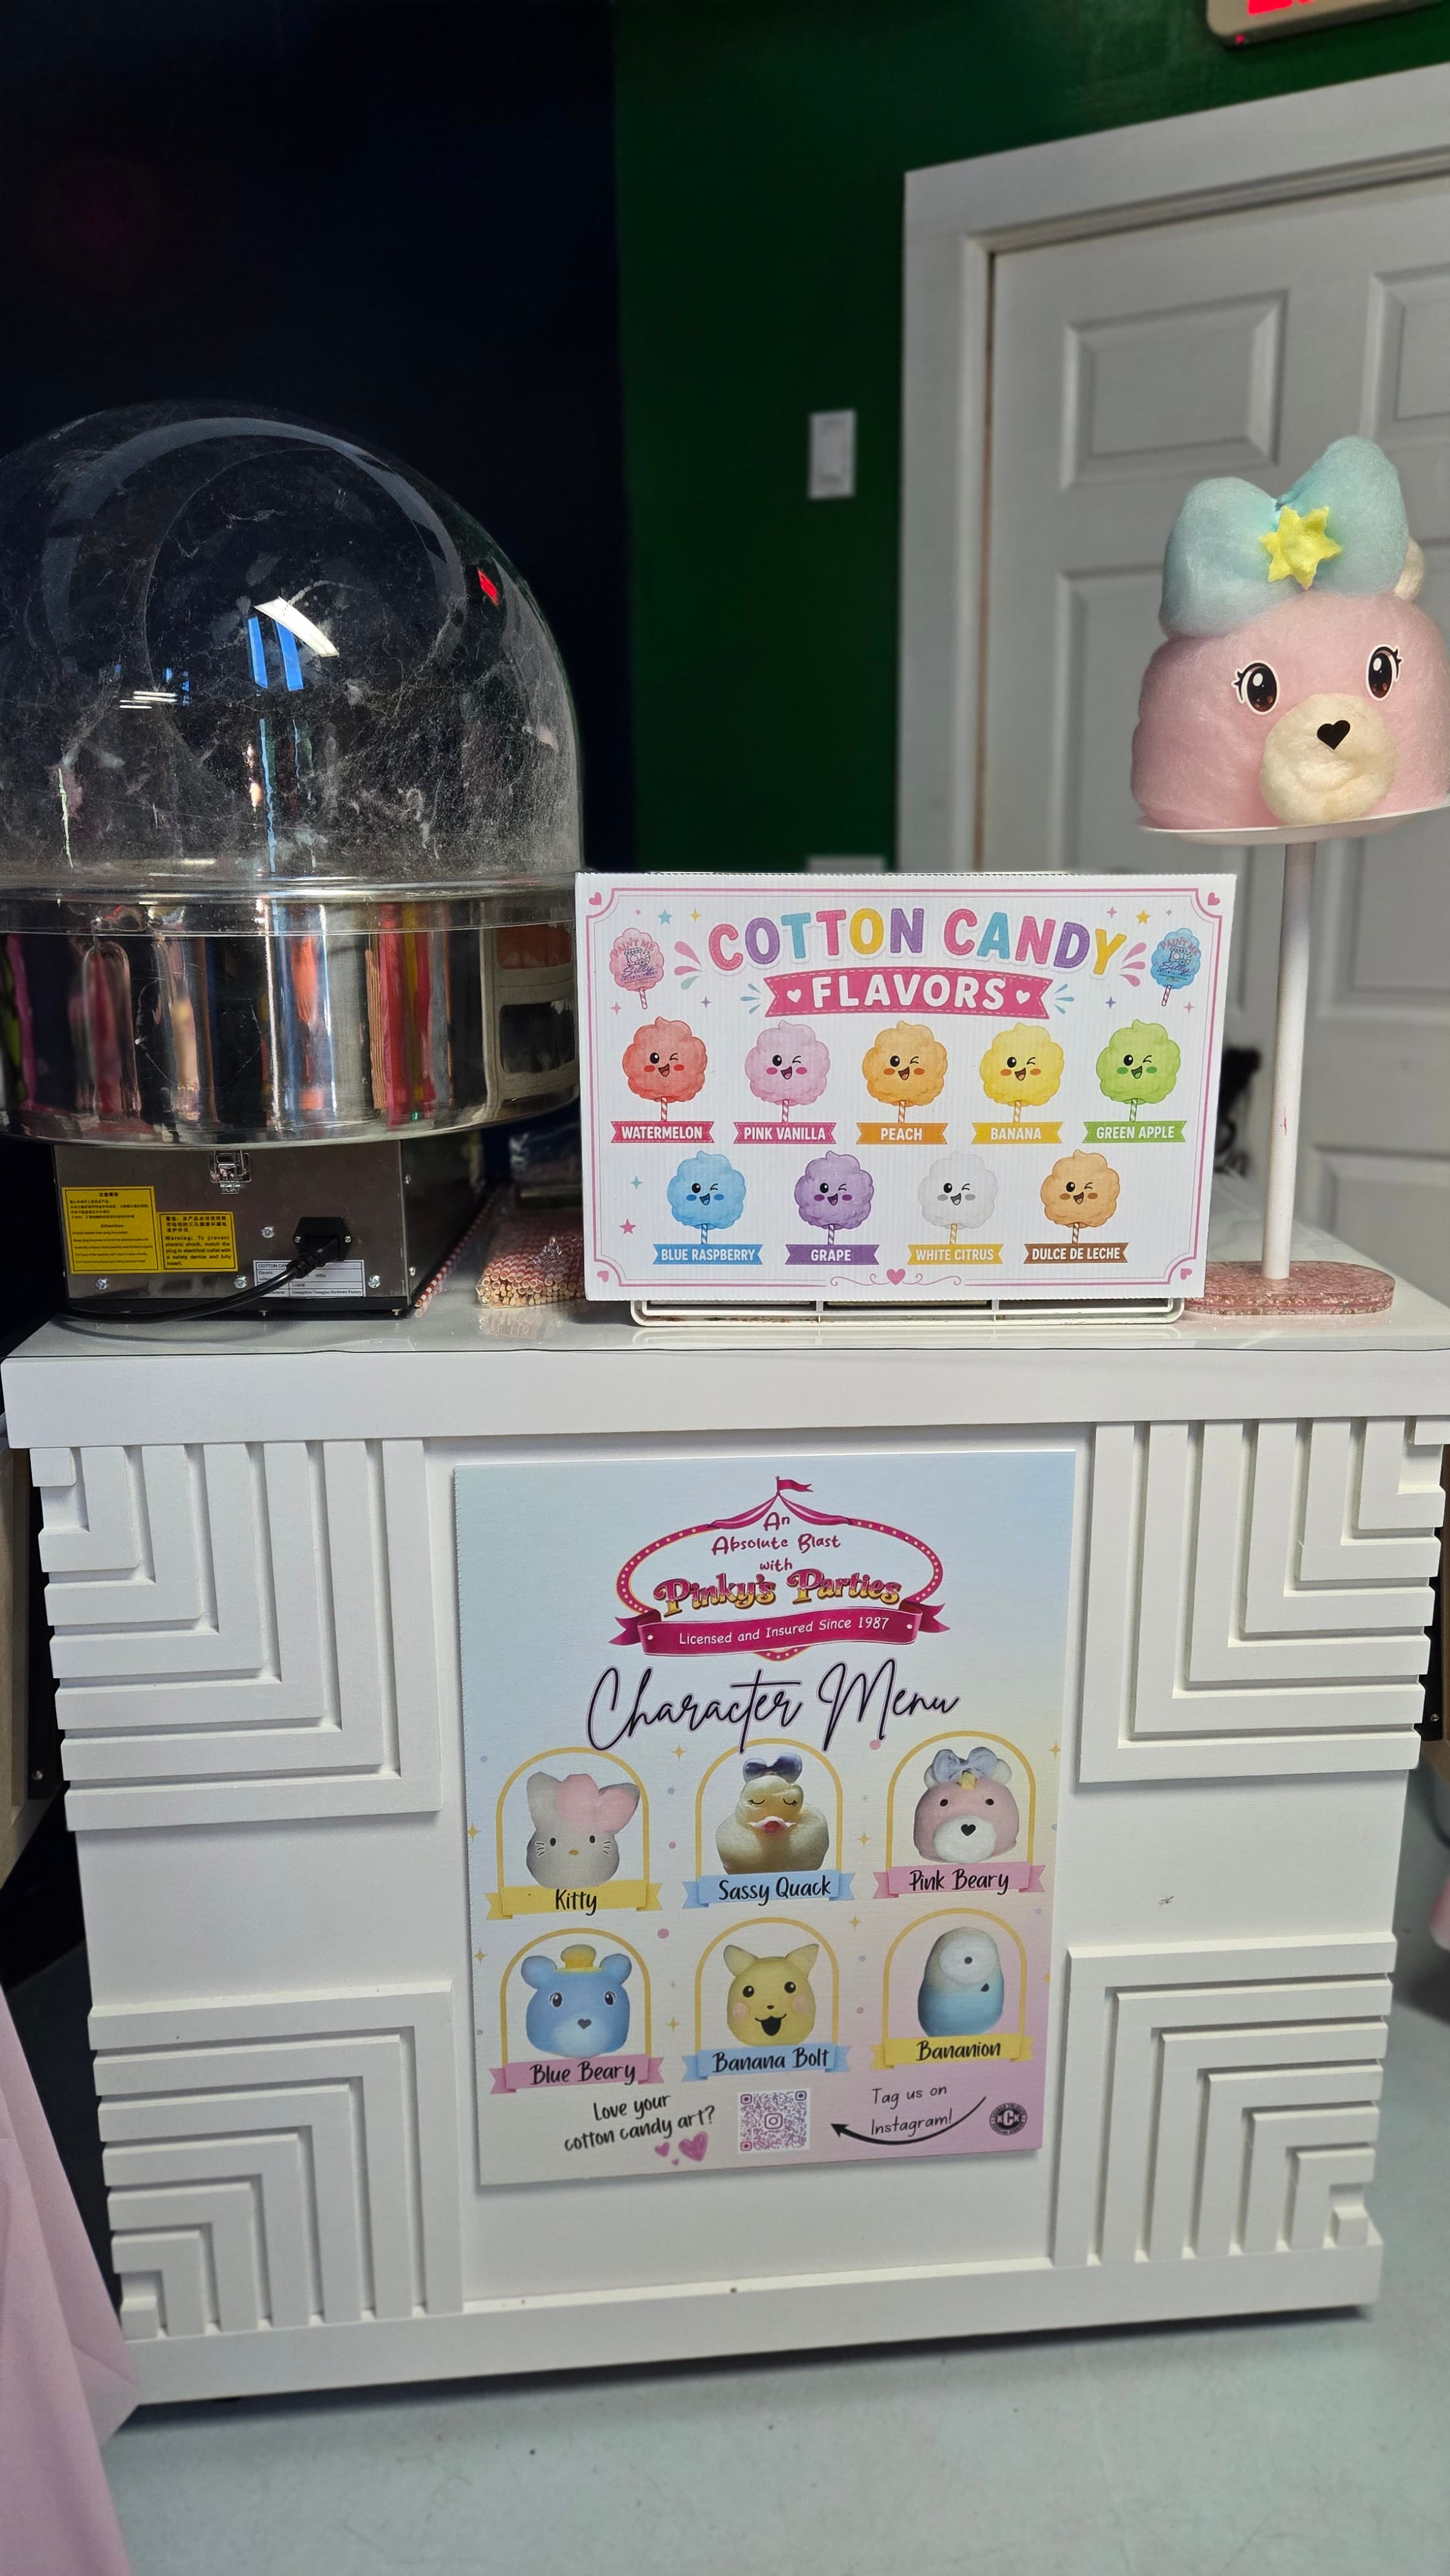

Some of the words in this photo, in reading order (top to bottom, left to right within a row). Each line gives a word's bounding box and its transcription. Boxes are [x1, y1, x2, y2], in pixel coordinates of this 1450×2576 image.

[639, 940, 656, 951] ME
[708, 907, 925, 971] COTTON
[944, 908, 1127, 975] CANDY
[1160, 938, 1188, 950] PAINT
[811, 973, 1006, 1010] FLAVORS
[621, 1126, 702, 1139] WATERMELON
[744, 1127, 772, 1139] PINK
[777, 1127, 826, 1140] VANILLA
[880, 1128, 923, 1141] PEACH
[990, 1128, 1042, 1141] BANANA
[1096, 1126, 1135, 1139] GREEN
[1138, 1126, 1174, 1139] APPLE
[661, 1249, 688, 1261] BLUE
[692, 1249, 755, 1261] RASPBERRY
[811, 1249, 851, 1262] GRAPE
[916, 1249, 951, 1261] WHITE
[954, 1249, 994, 1261] CITRUS
[1032, 1247, 1067, 1260] DULCE
[1069, 1247, 1084, 1260] DE
[1087, 1247, 1120, 1260] LECHE
[762, 1511, 791, 1531] An
[711, 1535, 789, 1555] Absolute
[797, 1533, 842, 1553] Blast
[759, 1557, 793, 1572] with
[653, 1572, 777, 1618] Pinky's
[786, 1567, 902, 1605] Parties
[679, 1633, 732, 1645] Licensed
[737, 1630, 760, 1642] and
[766, 1622, 813, 1638] Insured
[818, 1617, 852, 1631] Since
[858, 1616, 890, 1630] 1987
[587, 1666, 803, 1754] Character
[817, 1658, 961, 1752] Menu
[719, 1880, 770, 1906] Sassy
[775, 1875, 831, 1899] Quack
[909, 1870, 945, 1891] Pink
[951, 1868, 1009, 1895] Beary
[555, 1888, 598, 1915] Kitty
[712, 2052, 786, 2073] Banana
[792, 2047, 830, 2068] Bolt
[916, 2040, 1001, 2061] Bananion
[529, 2063, 570, 2085] Blue
[577, 2061, 636, 2086] Beary
[593, 2102, 627, 2121] Love
[634, 2094, 671, 2119] your
[871, 2087, 899, 2110] Tag
[907, 2090, 923, 2100] us
[930, 2086, 947, 2096] on
[564, 2129, 615, 2152] cotton
[619, 2117, 673, 2139] candy
[677, 2105, 715, 2129] art?
[871, 2107, 952, 2137] Instagram!
